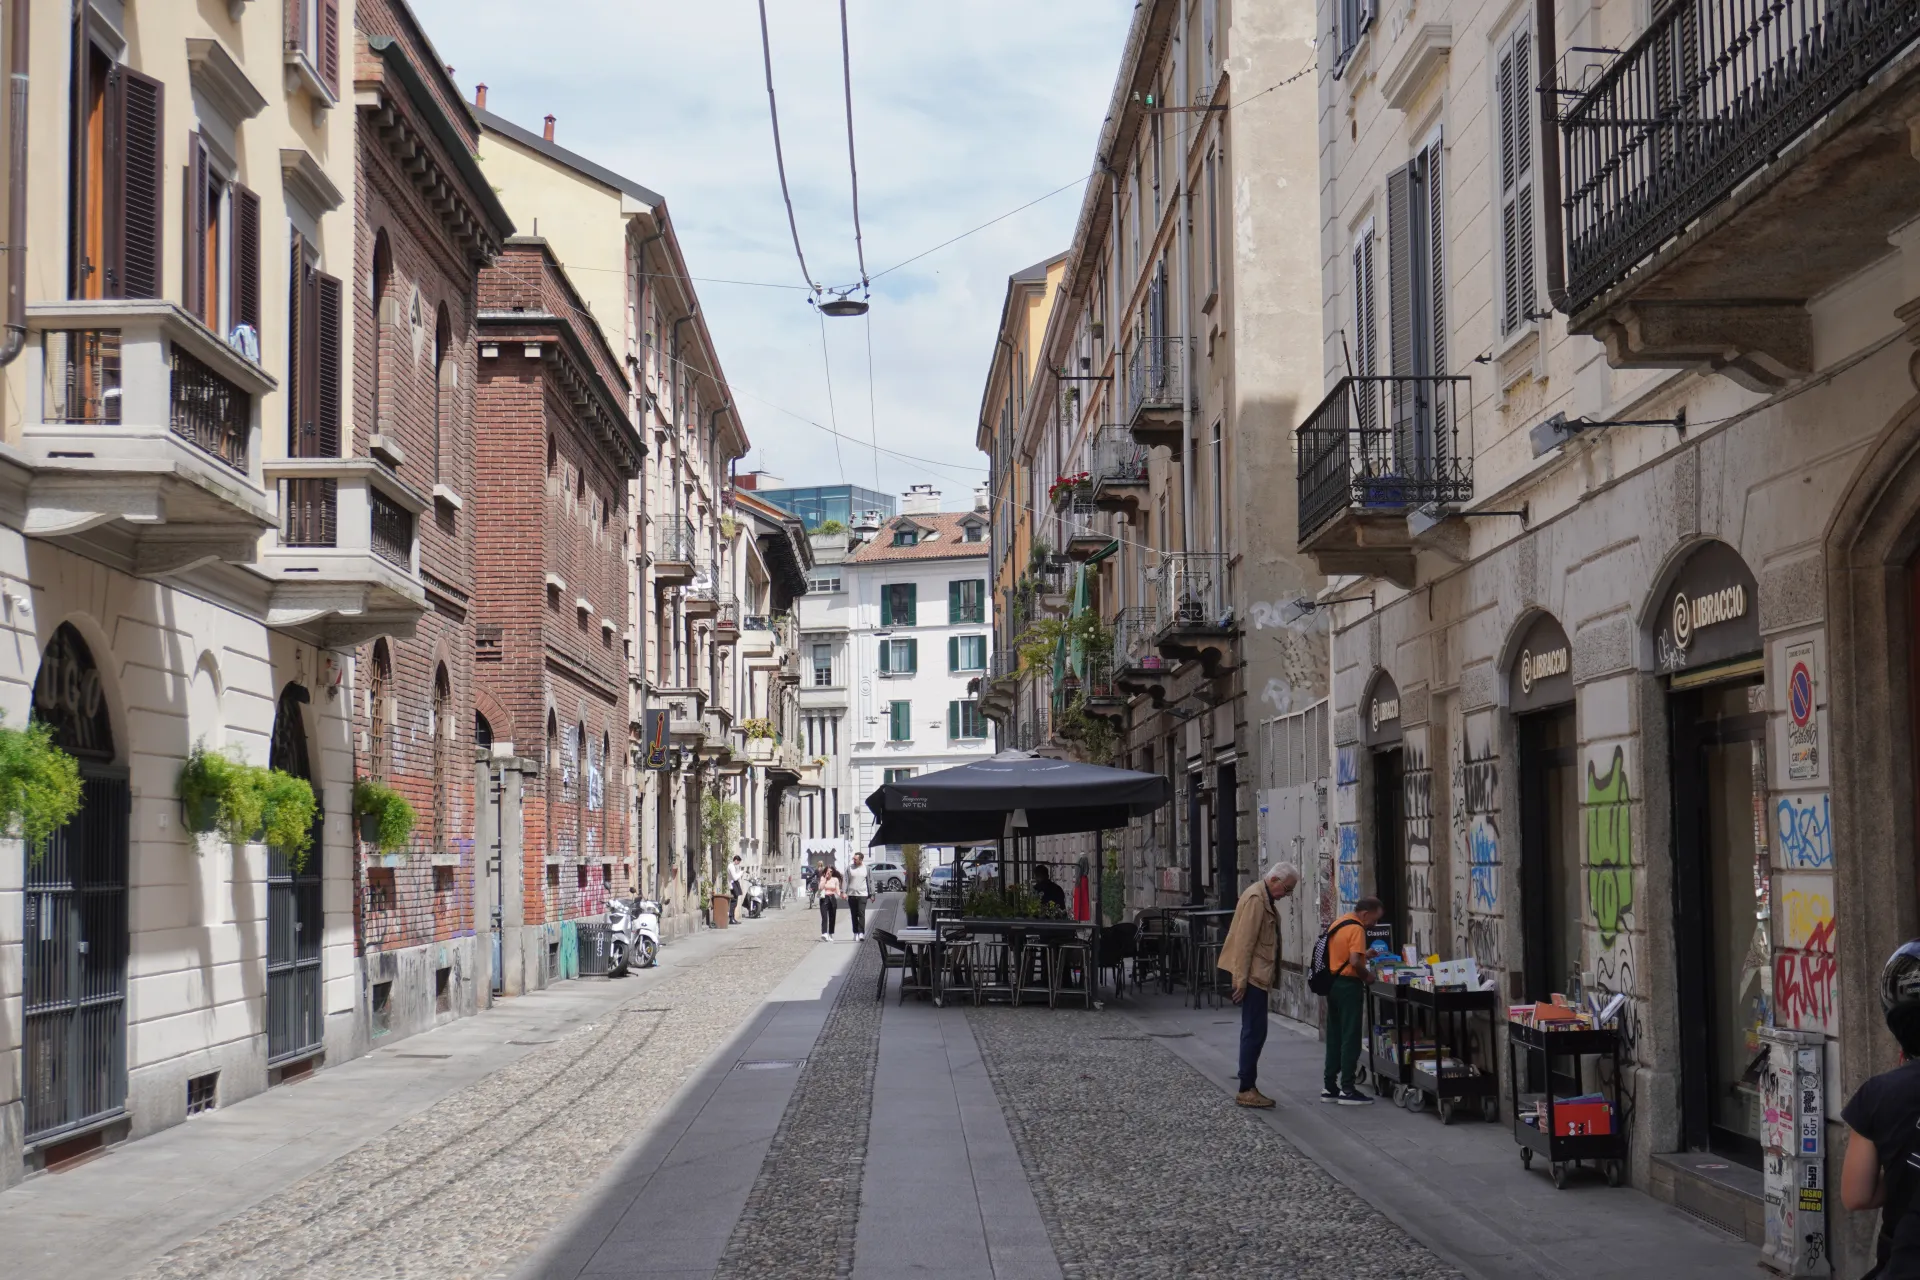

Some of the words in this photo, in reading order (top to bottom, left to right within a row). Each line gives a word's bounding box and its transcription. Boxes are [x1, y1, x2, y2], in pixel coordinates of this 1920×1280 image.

[1692, 584, 1744, 629] LIBRACCIO
[1532, 647, 1567, 680] LIBRACCIO
[1379, 699, 1399, 722] LIBRACCIO
[1803, 1123, 1809, 1136] OF
[1807, 1165, 1817, 1189] GAS
[1800, 1188, 1822, 1199] LOSKO
[1799, 1201, 1822, 1211] MUGO
